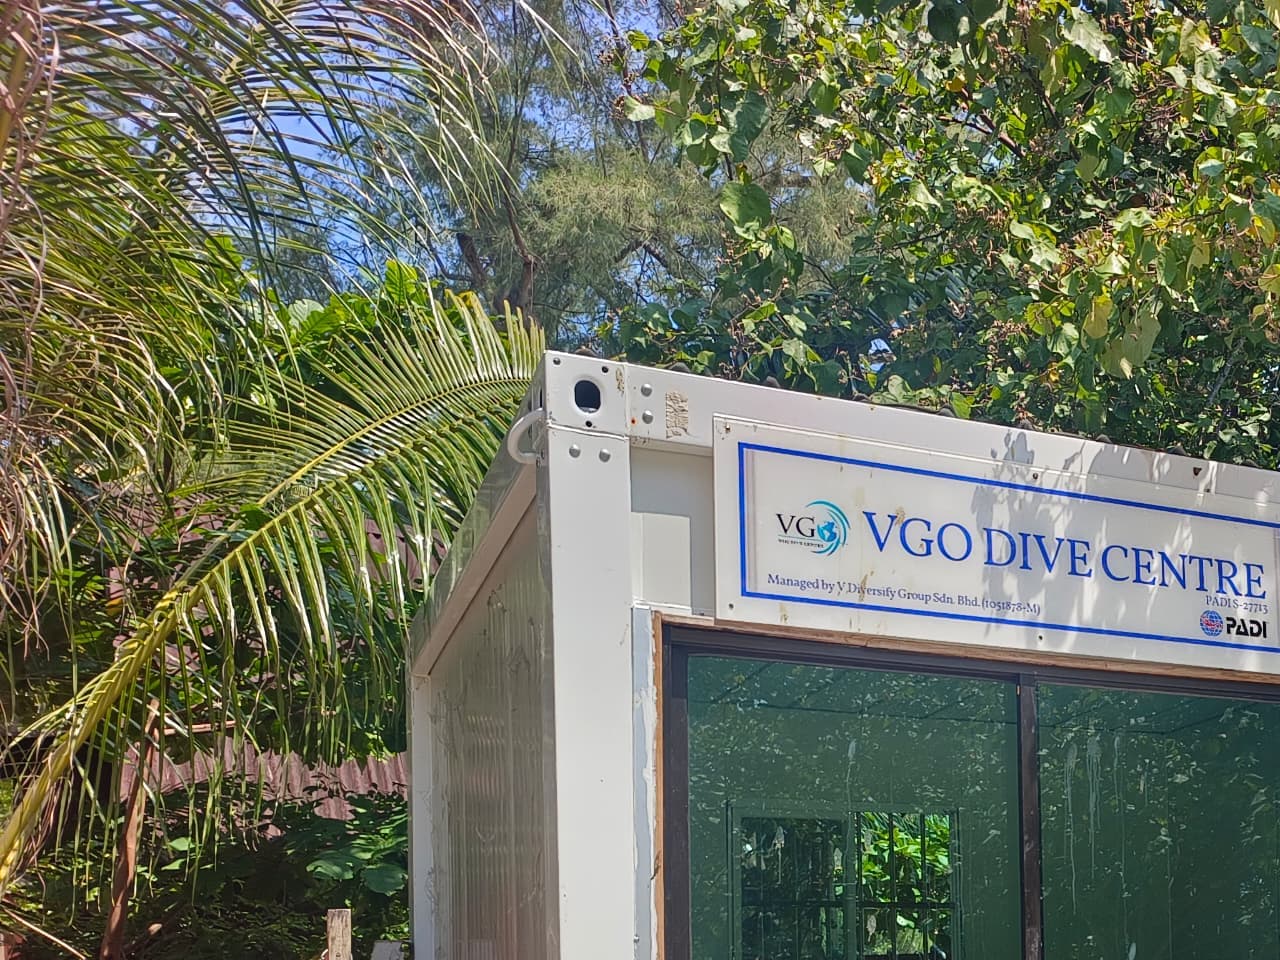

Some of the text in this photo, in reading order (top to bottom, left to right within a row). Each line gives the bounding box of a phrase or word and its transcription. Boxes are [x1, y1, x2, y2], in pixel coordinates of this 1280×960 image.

[862, 511, 1267, 600] VGO DIVE CENTRE
[767, 573, 819, 591] Managed
[821, 580, 835, 593] by
[847, 582, 896, 600] Diversify
[897, 588, 931, 604] Group
[1206, 595, 1231, 608] PADI
[1226, 616, 1268, 638] PADI
